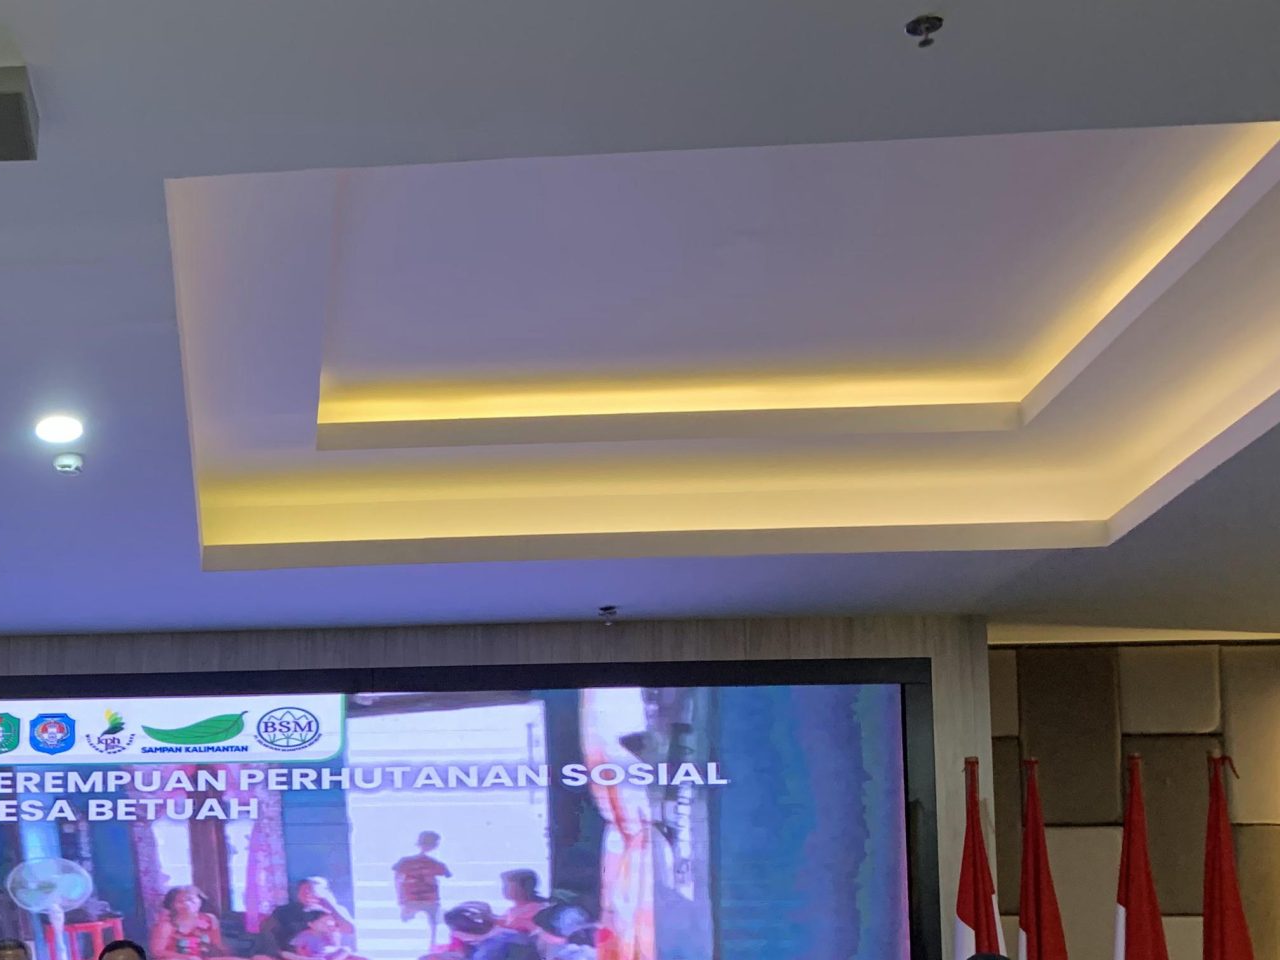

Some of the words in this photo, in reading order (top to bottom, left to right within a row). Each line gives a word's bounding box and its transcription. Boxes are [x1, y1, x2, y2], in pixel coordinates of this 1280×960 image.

[263, 720, 314, 733] BSM
[184, 745, 248, 753] KALIMANTAN
[239, 764, 549, 791] PERHUTANAN
[561, 762, 728, 787] SOSIAL
[88, 798, 259, 821] BETUAH
